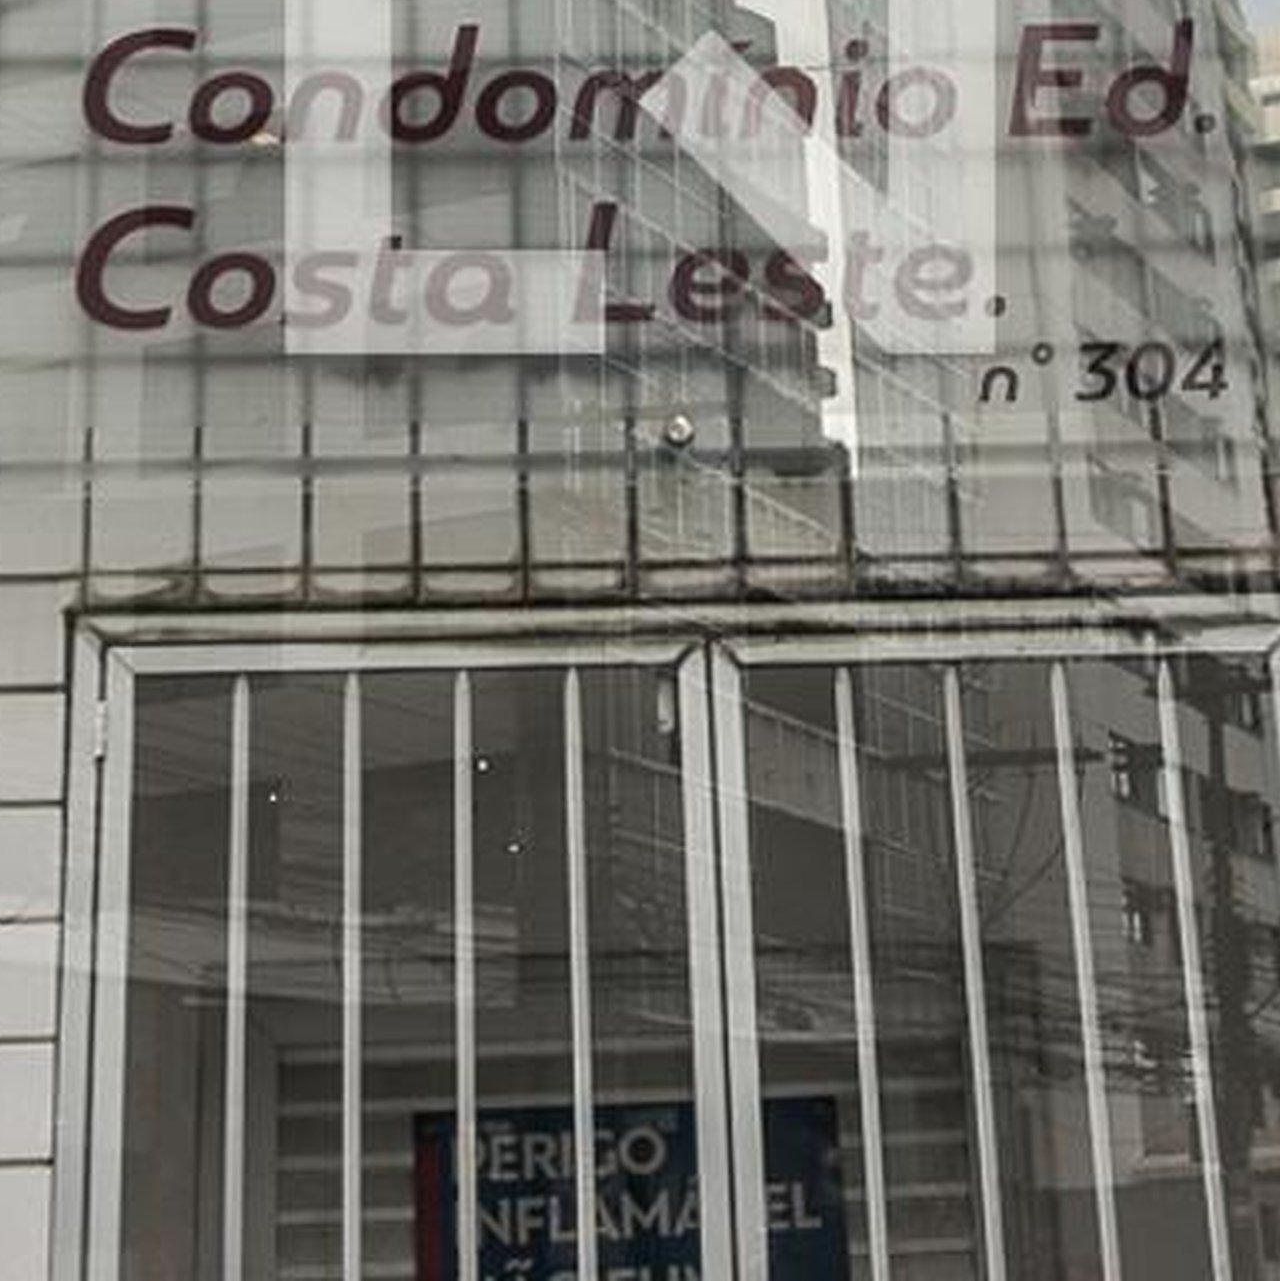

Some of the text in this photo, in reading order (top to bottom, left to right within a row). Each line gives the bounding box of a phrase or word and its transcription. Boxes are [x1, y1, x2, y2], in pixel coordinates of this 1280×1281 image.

[82, 18, 1215, 146] Condomínio Ed.
[75, 202, 1007, 331] Costa Leste.
[456, 1172, 823, 1246] NFLAMÁEL
